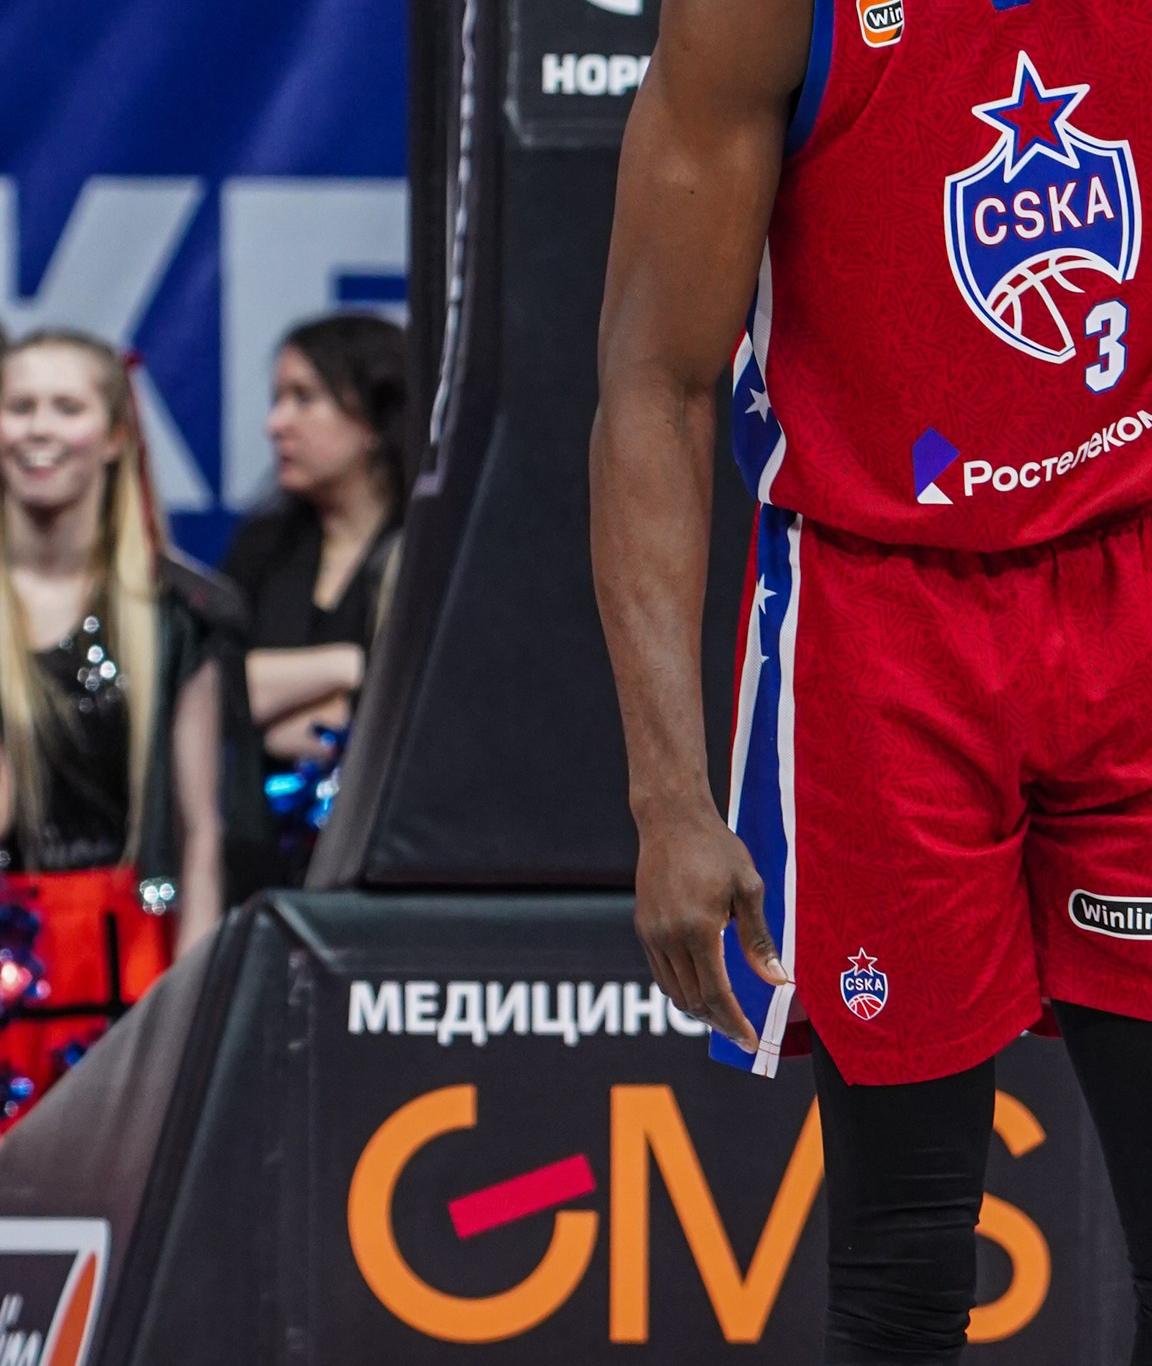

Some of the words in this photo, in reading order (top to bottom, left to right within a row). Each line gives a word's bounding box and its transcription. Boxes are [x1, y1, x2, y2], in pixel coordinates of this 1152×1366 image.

[868, 6, 903, 28] Win
[974, 175, 1115, 246] CSKA
[1084, 298, 1129, 395] 3
[845, 977, 884, 993] CSKA
